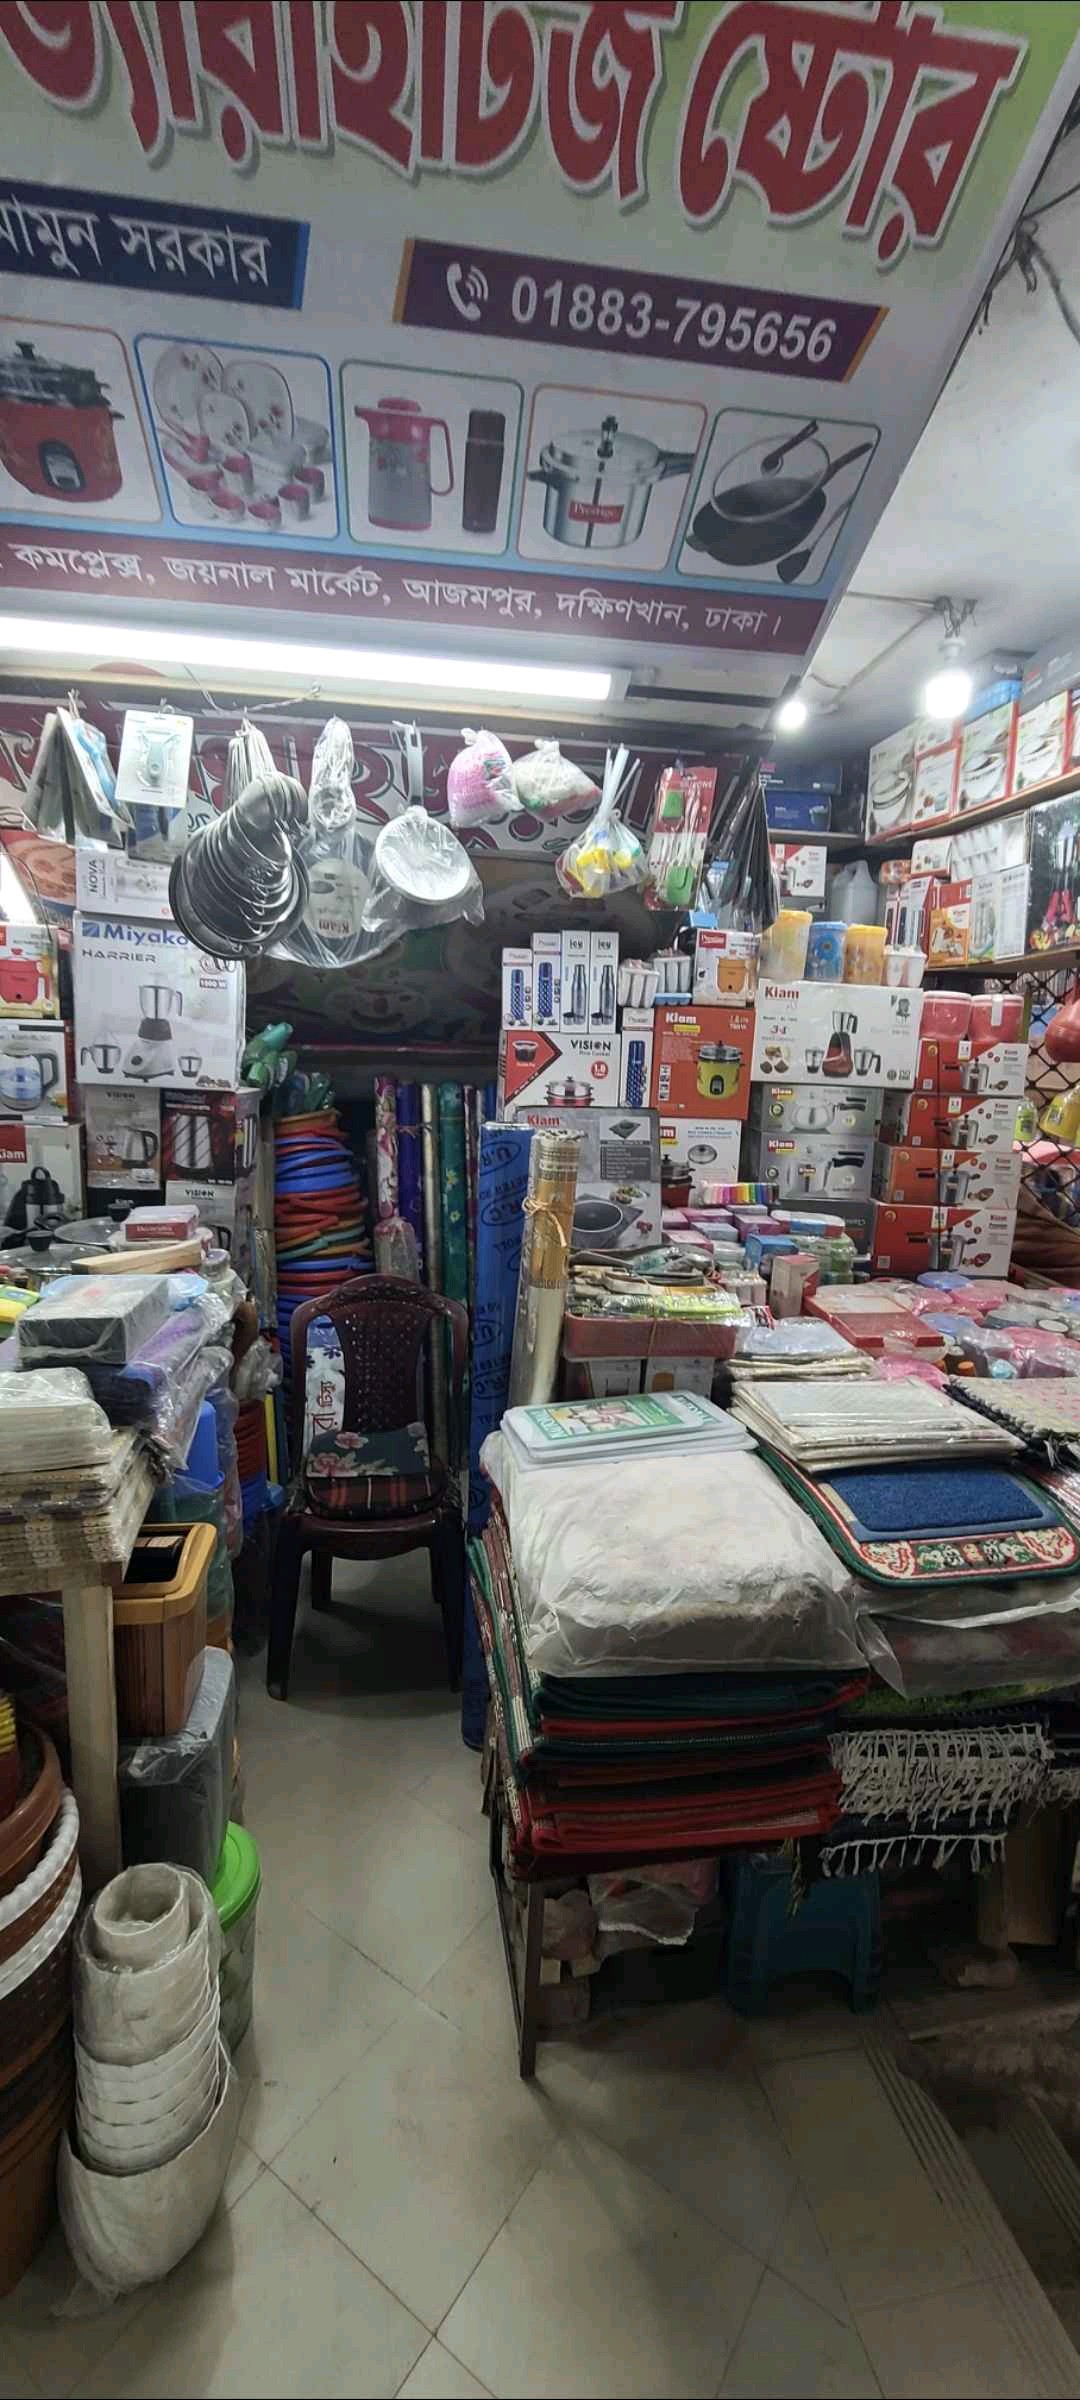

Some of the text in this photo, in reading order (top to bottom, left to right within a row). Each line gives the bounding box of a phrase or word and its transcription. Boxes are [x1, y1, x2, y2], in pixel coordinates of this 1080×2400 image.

[110, 214, 271, 288] সরকার
[511, 276, 838, 364] 01883-795656
[162, 555, 278, 591] জয়নাল
[285, 567, 391, 605] মার্কেট,
[402, 578, 542, 618] আজমপুর,
[556, 589, 690, 631] দক্ষিণখান,
[104, 924, 189, 945] Miyako
[82, 950, 157, 963] HARRIER
[571, 1040, 611, 1050] VISION
[185, 1188, 215, 1198] VISION
